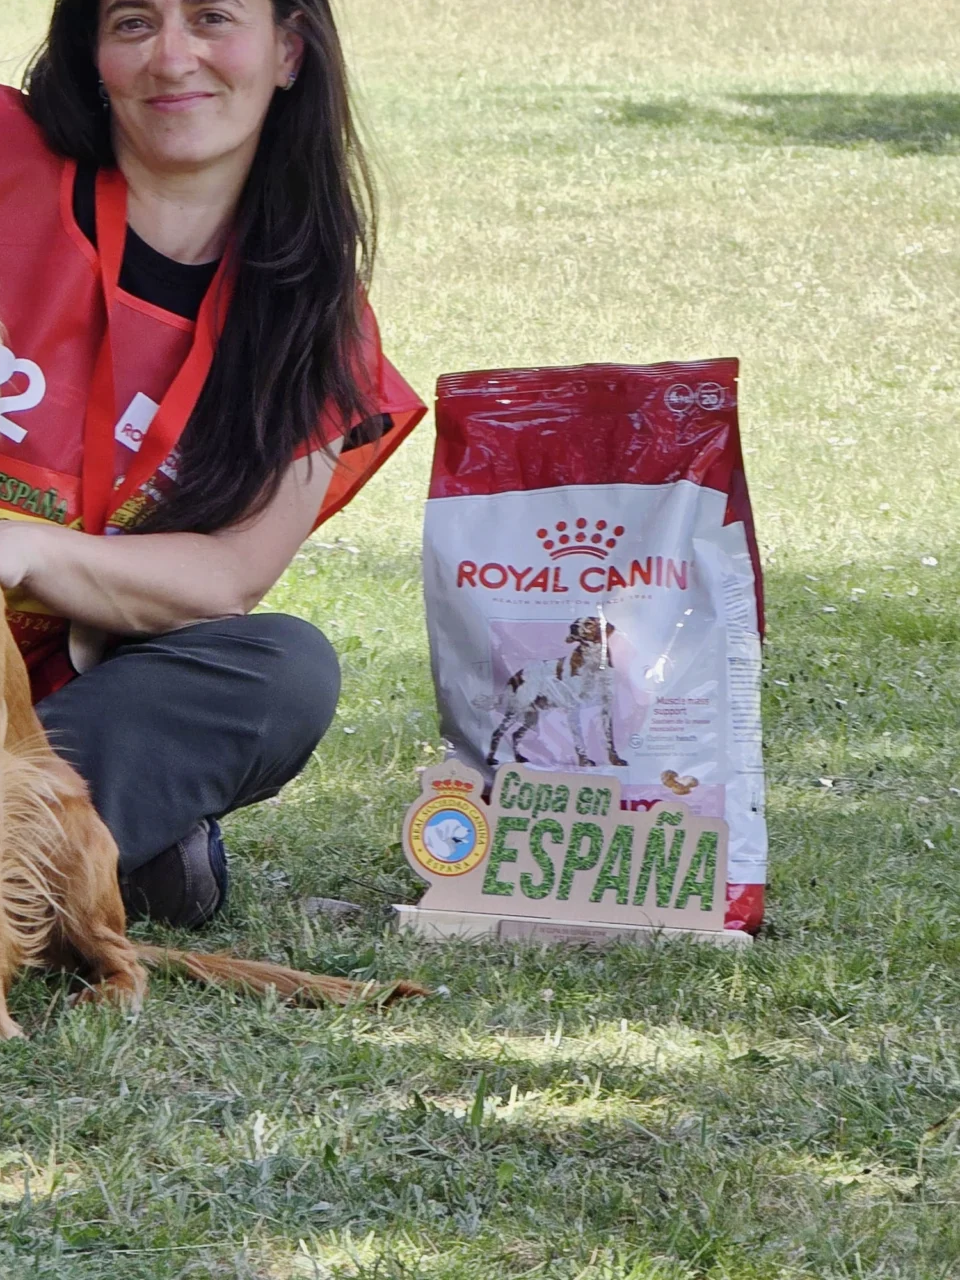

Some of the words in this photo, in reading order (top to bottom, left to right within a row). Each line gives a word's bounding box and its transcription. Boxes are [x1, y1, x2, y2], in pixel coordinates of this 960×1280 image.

[457, 560, 569, 593] ROYAL
[579, 556, 688, 594] CANIN
[500, 771, 570, 818] Copa
[575, 786, 611, 816] en
[413, 819, 423, 840] REAL
[422, 799, 469, 817] SOCIEDAD
[468, 809, 488, 845] CANINA
[425, 858, 471, 873] ESPAÑA
[481, 811, 719, 911] ESPAÑA
